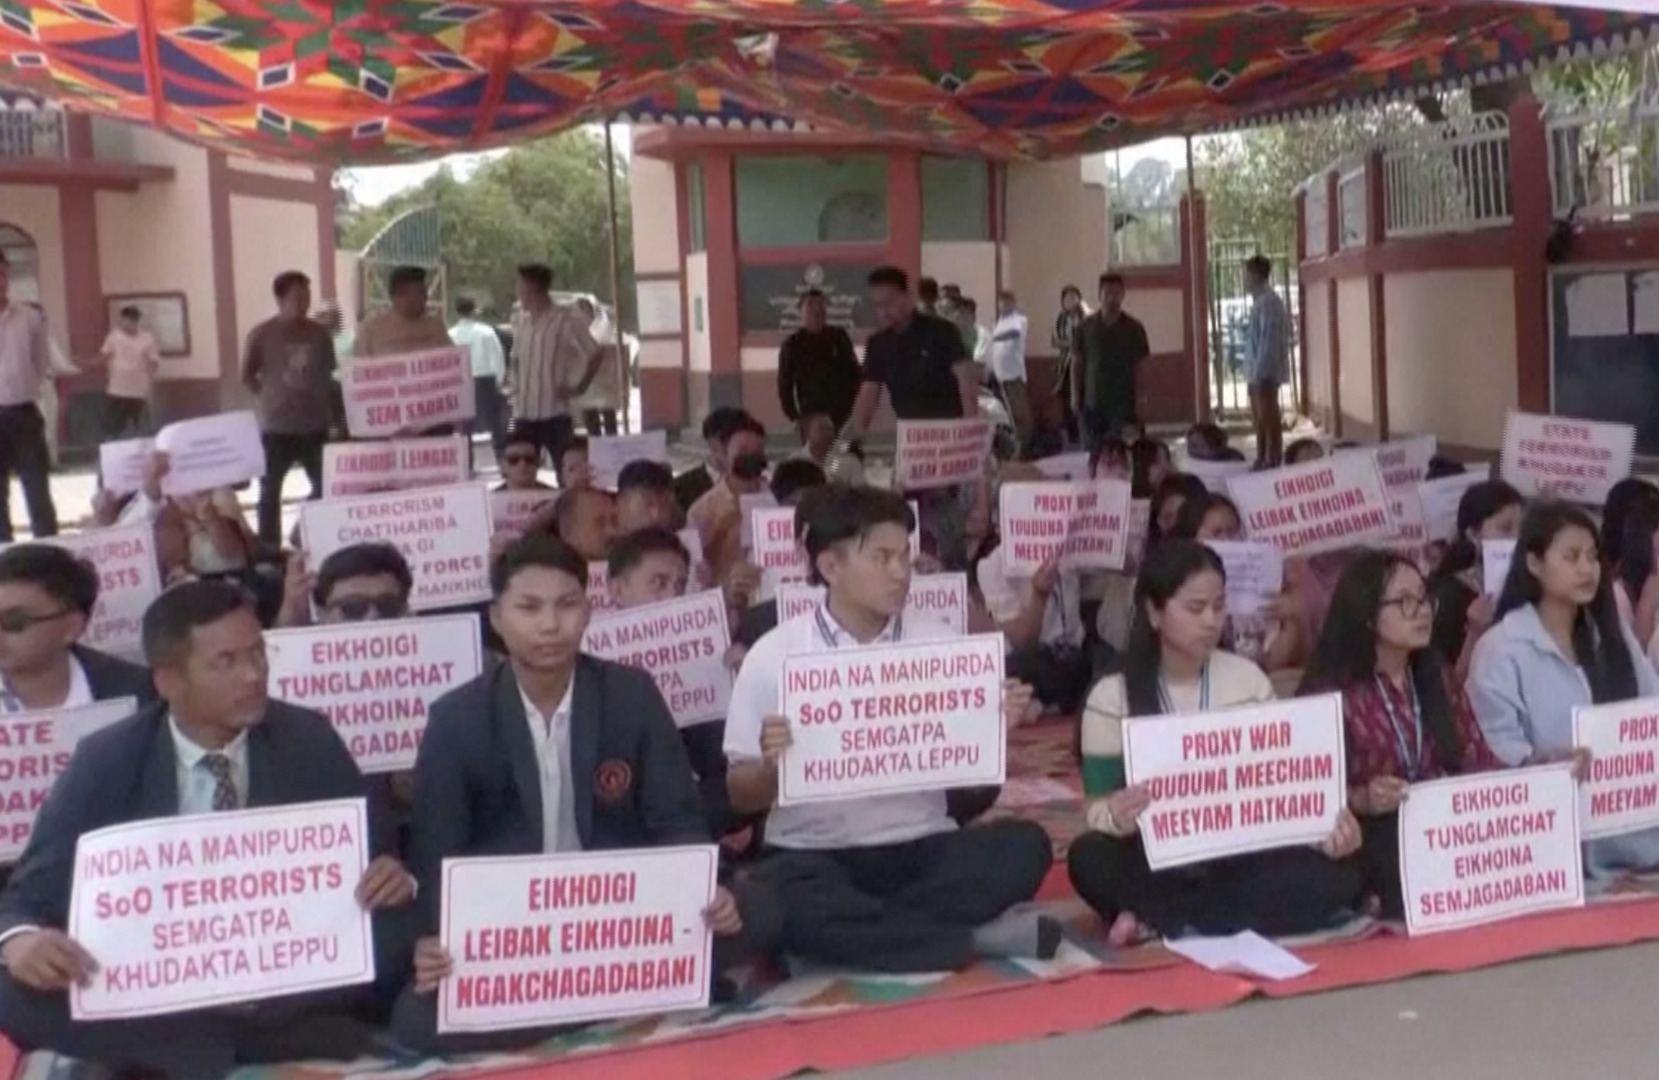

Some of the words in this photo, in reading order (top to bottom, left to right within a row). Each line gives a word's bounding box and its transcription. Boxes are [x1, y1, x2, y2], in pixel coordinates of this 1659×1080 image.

[346, 496, 445, 520] TERRORISM
[1034, 494, 1073, 512] PROXY
[423, 555, 483, 575] FORCE
[587, 630, 612, 653] NA
[616, 605, 718, 645] MANIPURDA
[312, 634, 417, 664] EIKHOIGI
[278, 662, 454, 699] TUNGLAMCHAT
[788, 669, 841, 694] INDIA
[848, 665, 874, 688] NA
[881, 653, 995, 684] MANIPURDA
[326, 697, 425, 727] IKHOINA
[670, 686, 715, 712] EPPU
[800, 702, 842, 725] SoO
[851, 687, 986, 719] TERRORISTS
[841, 722, 946, 752] SEMGATPA
[1183, 726, 1241, 760] PROXY
[1250, 721, 1292, 752] WAR
[1619, 714, 1659, 743] PROX
[804, 753, 912, 782] KHUDAKTA
[918, 745, 979, 771] LEPPU
[1149, 767, 1228, 800] OUDUNA
[1235, 753, 1333, 791] MEECHAM
[1151, 804, 1233, 843] MEEYAM
[1240, 792, 1326, 827] HATKANU
[1452, 783, 1529, 815] EIKHOIGI
[1424, 810, 1557, 850] TUNGLAMCHAT
[84, 846, 150, 880] INDIA
[158, 841, 193, 870] NA
[202, 823, 353, 863] MANIPURDA
[1454, 845, 1533, 879] EIKHOINA
[95, 887, 152, 920] SoO
[162, 863, 343, 909] TERRORISTS
[529, 872, 636, 912] EIKHOIGI
[1420, 870, 1566, 915] SEMJAGADABANI
[153, 908, 292, 950] SEMGATPA
[465, 924, 551, 962] LEIBAK
[561, 913, 674, 953] EIKHOINA
[105, 949, 250, 992] KHUDAKTA
[258, 935, 339, 973] LEPPU
[457, 955, 695, 1008] NGAKCHAGADABANI
